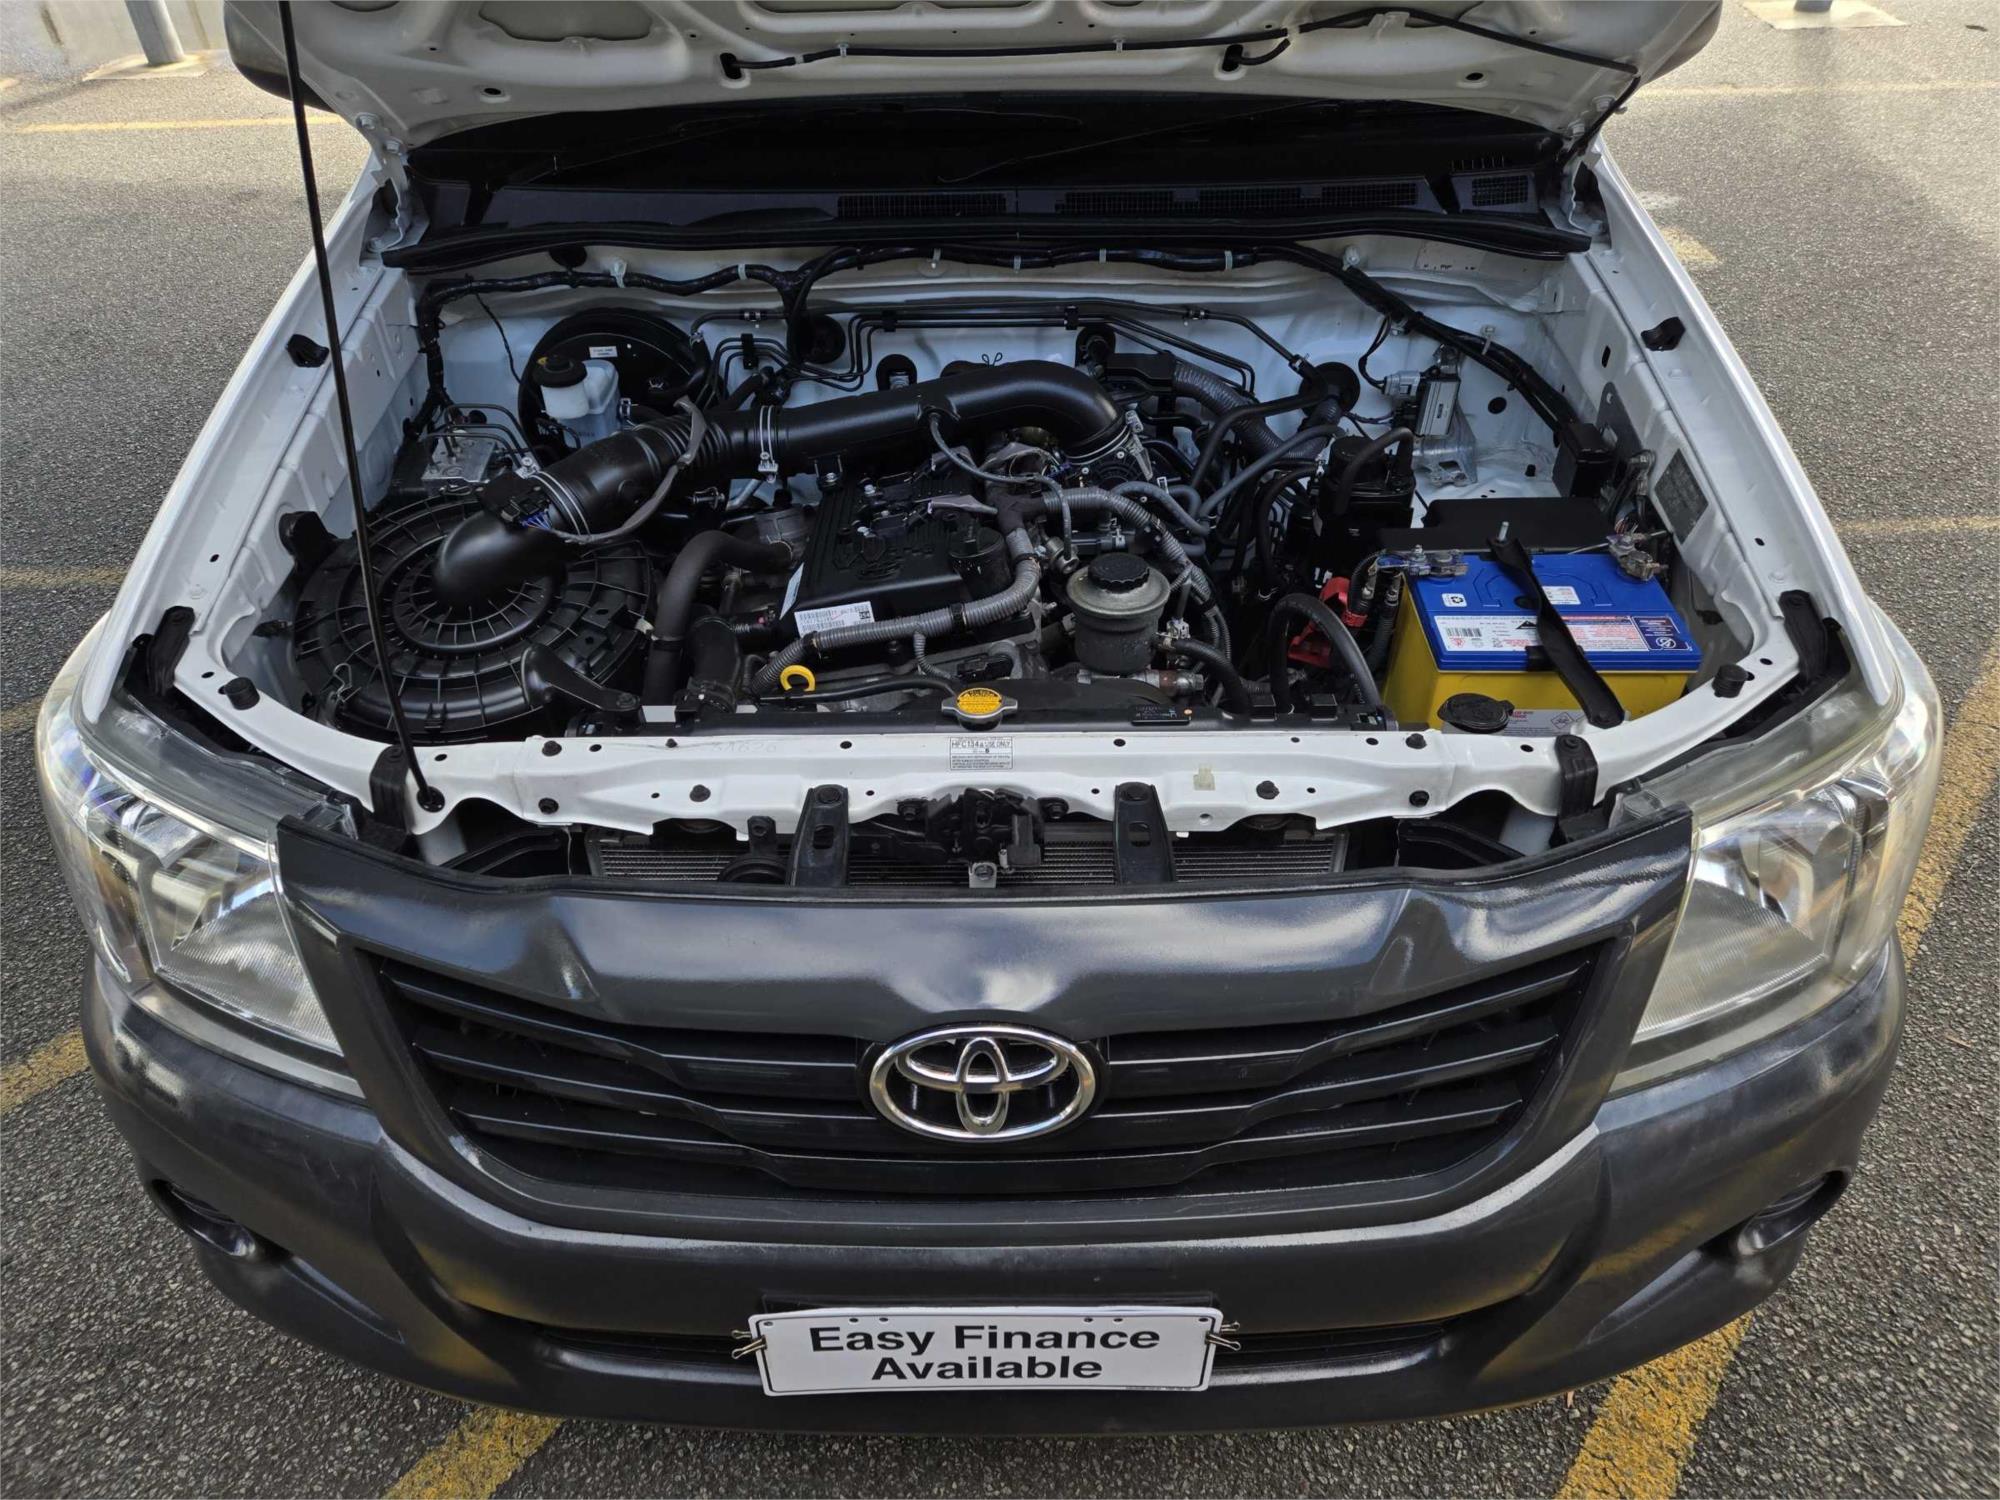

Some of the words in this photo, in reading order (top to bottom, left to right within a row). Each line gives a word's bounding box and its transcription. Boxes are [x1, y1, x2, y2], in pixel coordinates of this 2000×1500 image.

[810, 1326, 935, 1356] Easy
[954, 1325, 1160, 1349] Finance
[871, 1355, 1102, 1381] Available
